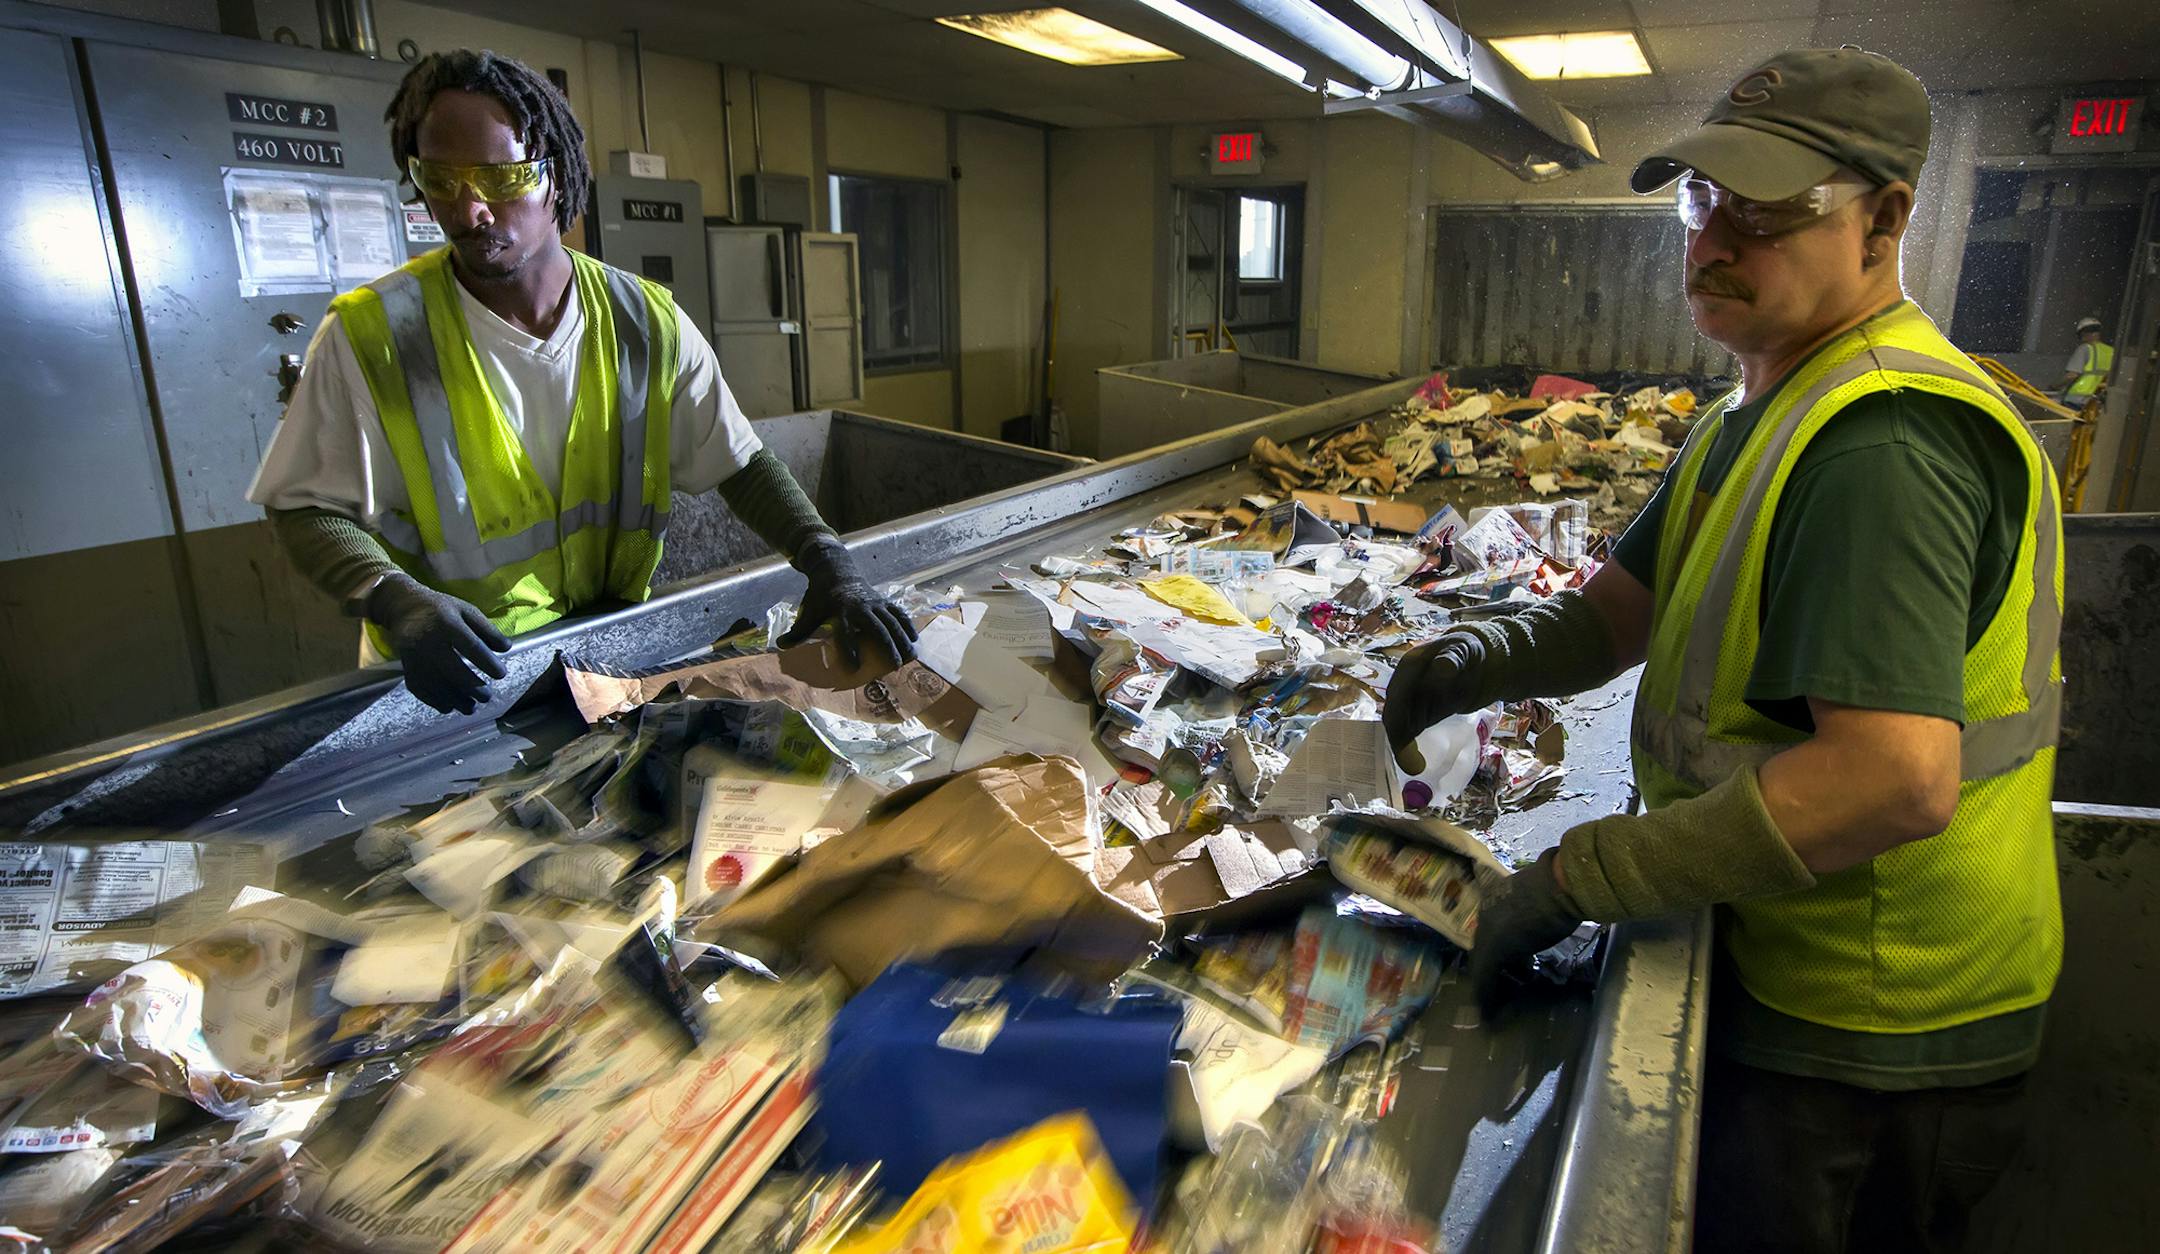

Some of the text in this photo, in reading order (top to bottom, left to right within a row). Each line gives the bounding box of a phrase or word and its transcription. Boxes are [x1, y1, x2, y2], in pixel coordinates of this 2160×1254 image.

[1729, 68, 1782, 106] C
[239, 98, 330, 128] MCC #2
[2069, 98, 2135, 137] EXIT
[237, 138, 343, 166] 460 VOLT
[1218, 133, 1254, 163] EXIT
[630, 201, 677, 220] MCC #1
[57, 922, 106, 931] ADVISOR
[991, 1188, 1081, 1239] Nilla
